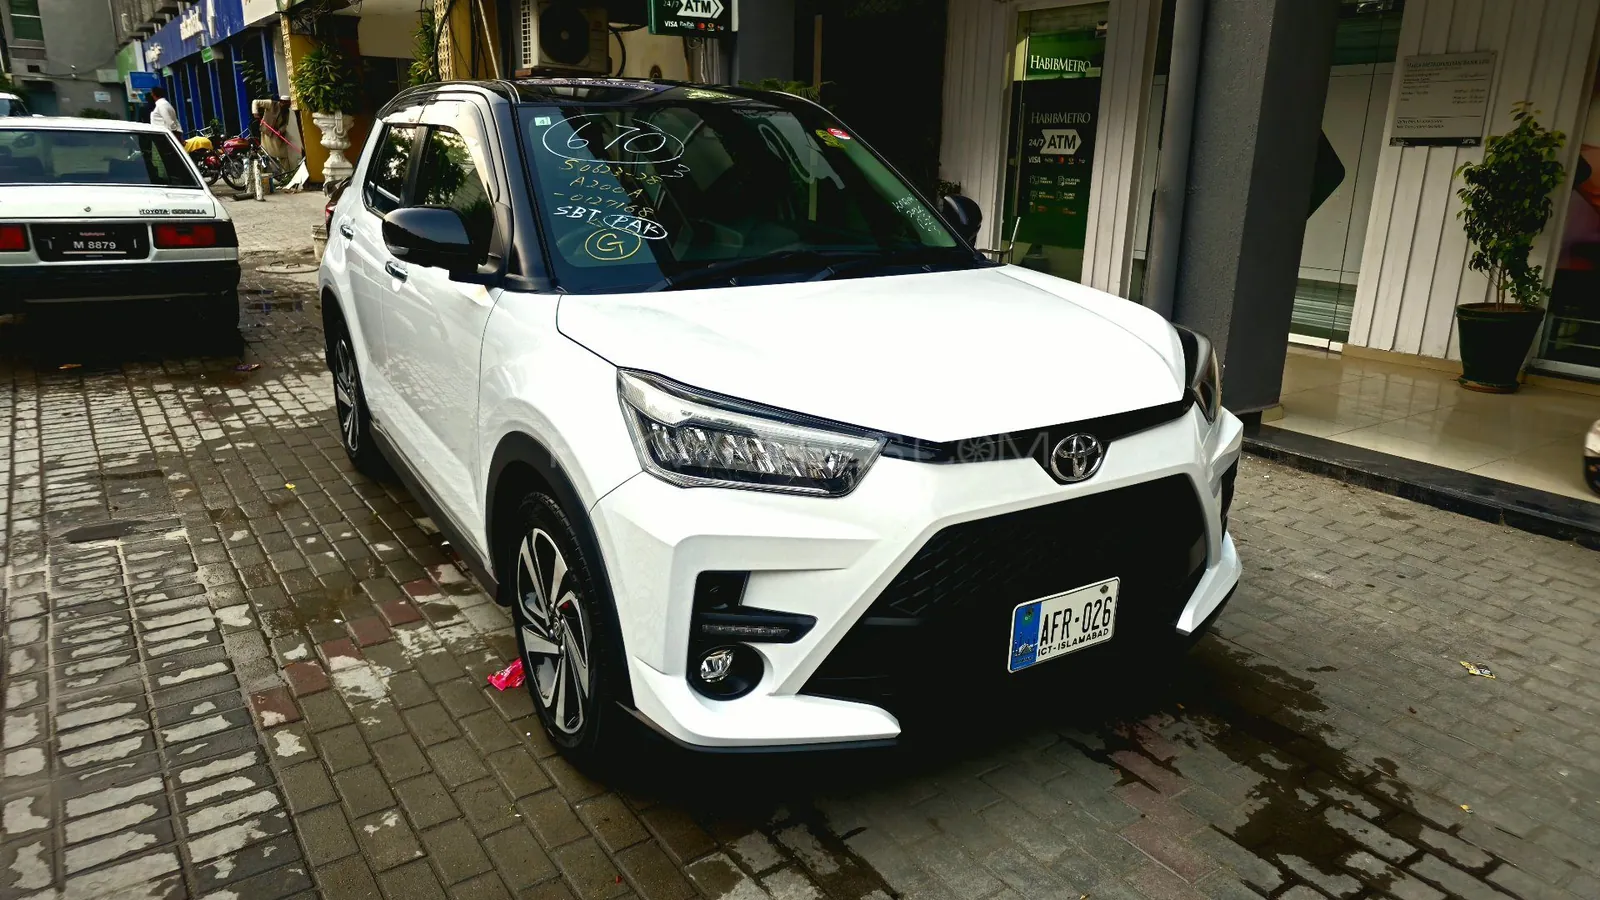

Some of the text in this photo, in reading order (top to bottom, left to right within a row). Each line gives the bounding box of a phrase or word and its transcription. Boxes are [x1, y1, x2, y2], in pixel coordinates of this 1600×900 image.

[684, 0, 712, 13] ATM
[664, 20, 678, 28] VISA
[567, 121, 667, 154] 670
[1028, 134, 1077, 150] 24/7 ATM
[1028, 156, 1041, 164] VISA
[553, 205, 660, 234] SBT PAK
[73, 240, 117, 250] M 8879
[596, 233, 625, 255] G
[1039, 596, 1112, 647] AFR-026
[1038, 628, 1109, 657] ICT-ISLAMABAD
